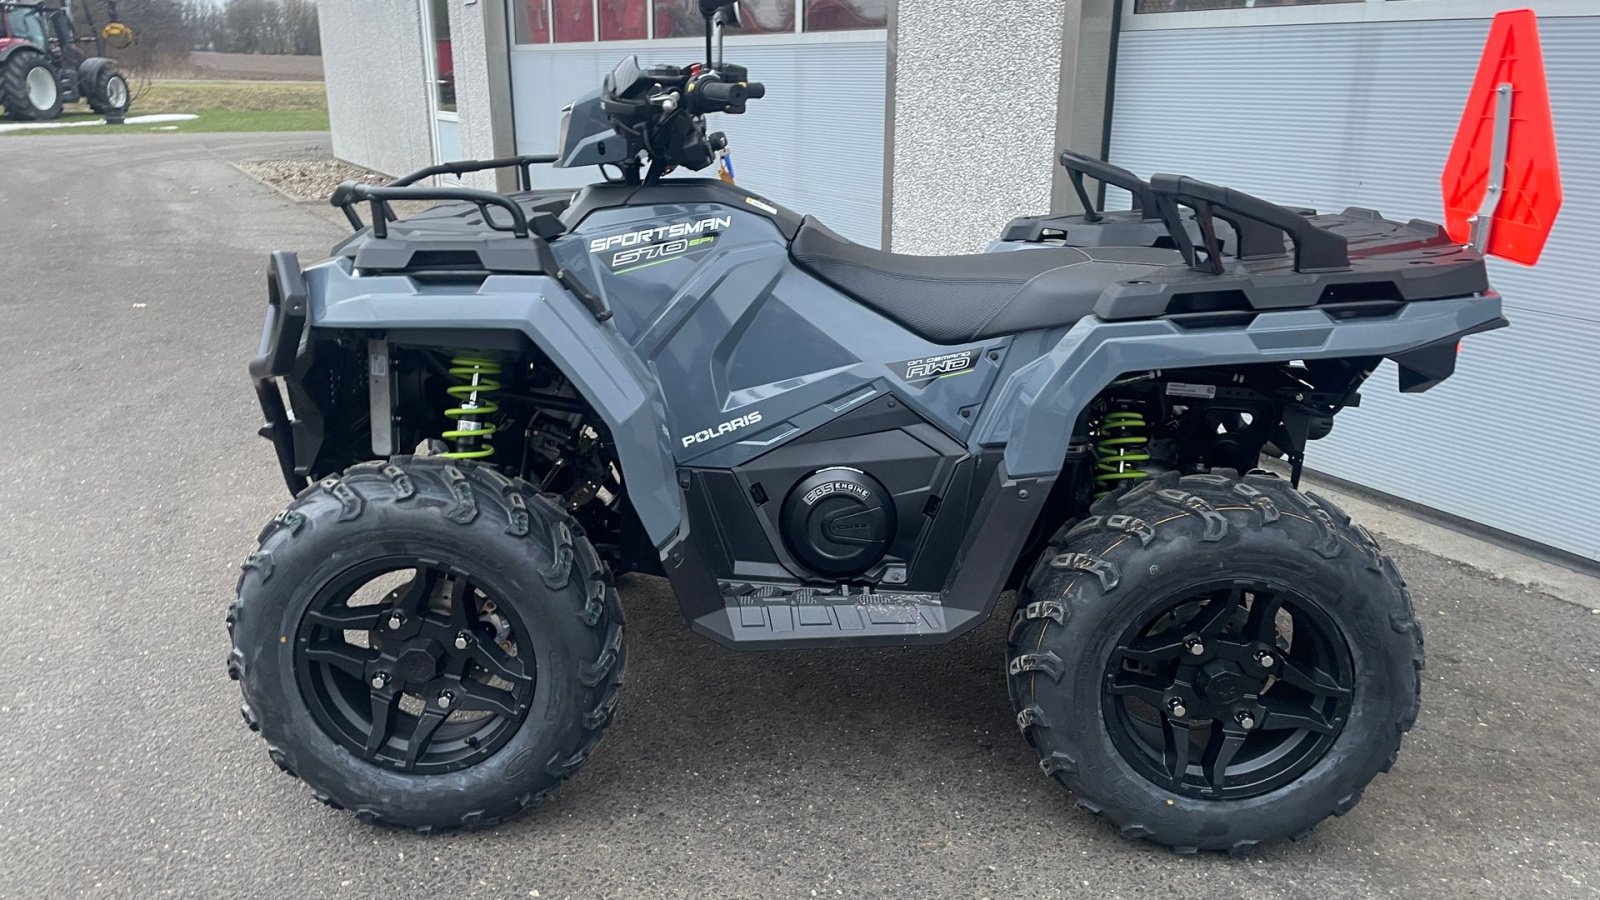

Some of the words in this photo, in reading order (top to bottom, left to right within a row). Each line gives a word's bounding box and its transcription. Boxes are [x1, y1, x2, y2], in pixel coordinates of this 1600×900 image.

[589, 215, 732, 253] SPORTSMAN
[612, 238, 689, 268] 570
[905, 357, 970, 379] AWD
[926, 350, 971, 363] DEMAND
[681, 410, 762, 448] POLARIS
[805, 483, 834, 503] EBS
[835, 482, 870, 498] ENGINE
